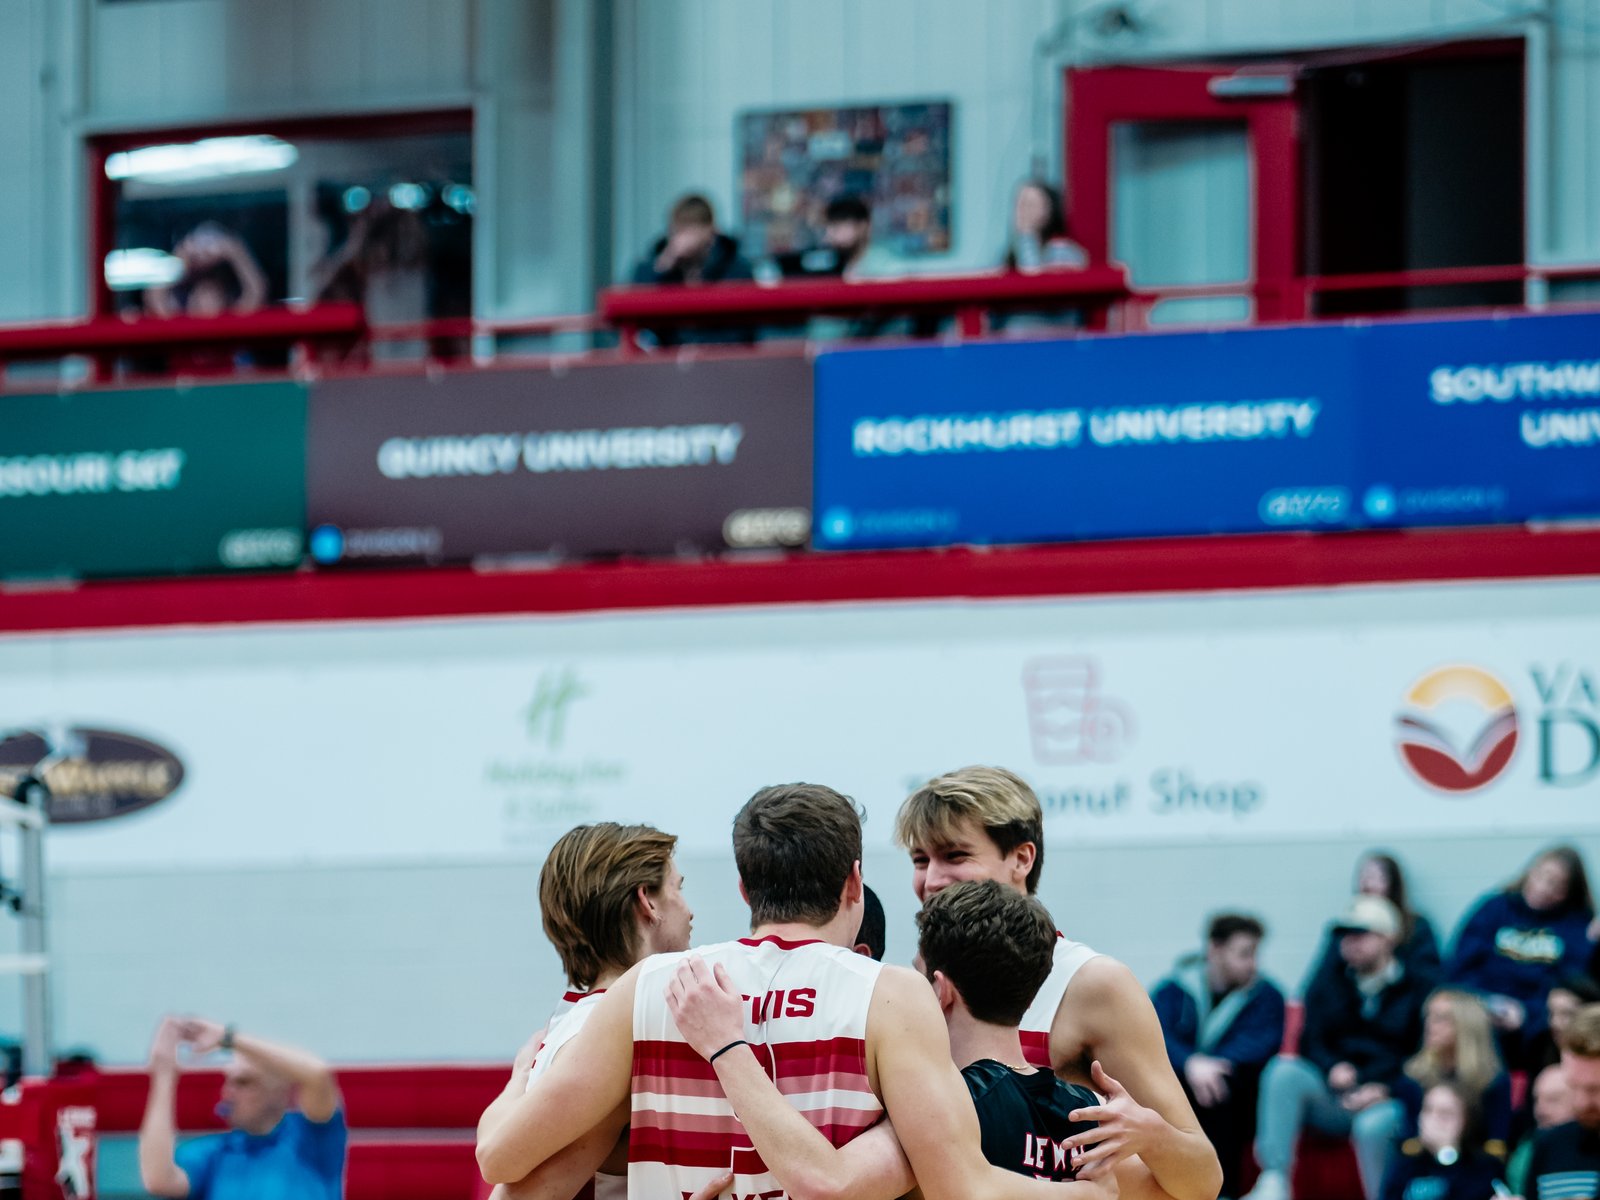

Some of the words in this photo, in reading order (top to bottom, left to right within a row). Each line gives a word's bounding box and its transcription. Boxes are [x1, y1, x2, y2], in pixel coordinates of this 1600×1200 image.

[378, 433, 521, 478] QUINCY
[523, 423, 743, 473] UNIVERSITY
[853, 409, 1083, 455] ROCKHURST
[1090, 398, 1319, 445] UNIVERSITY
[1149, 766, 1267, 823] Shop
